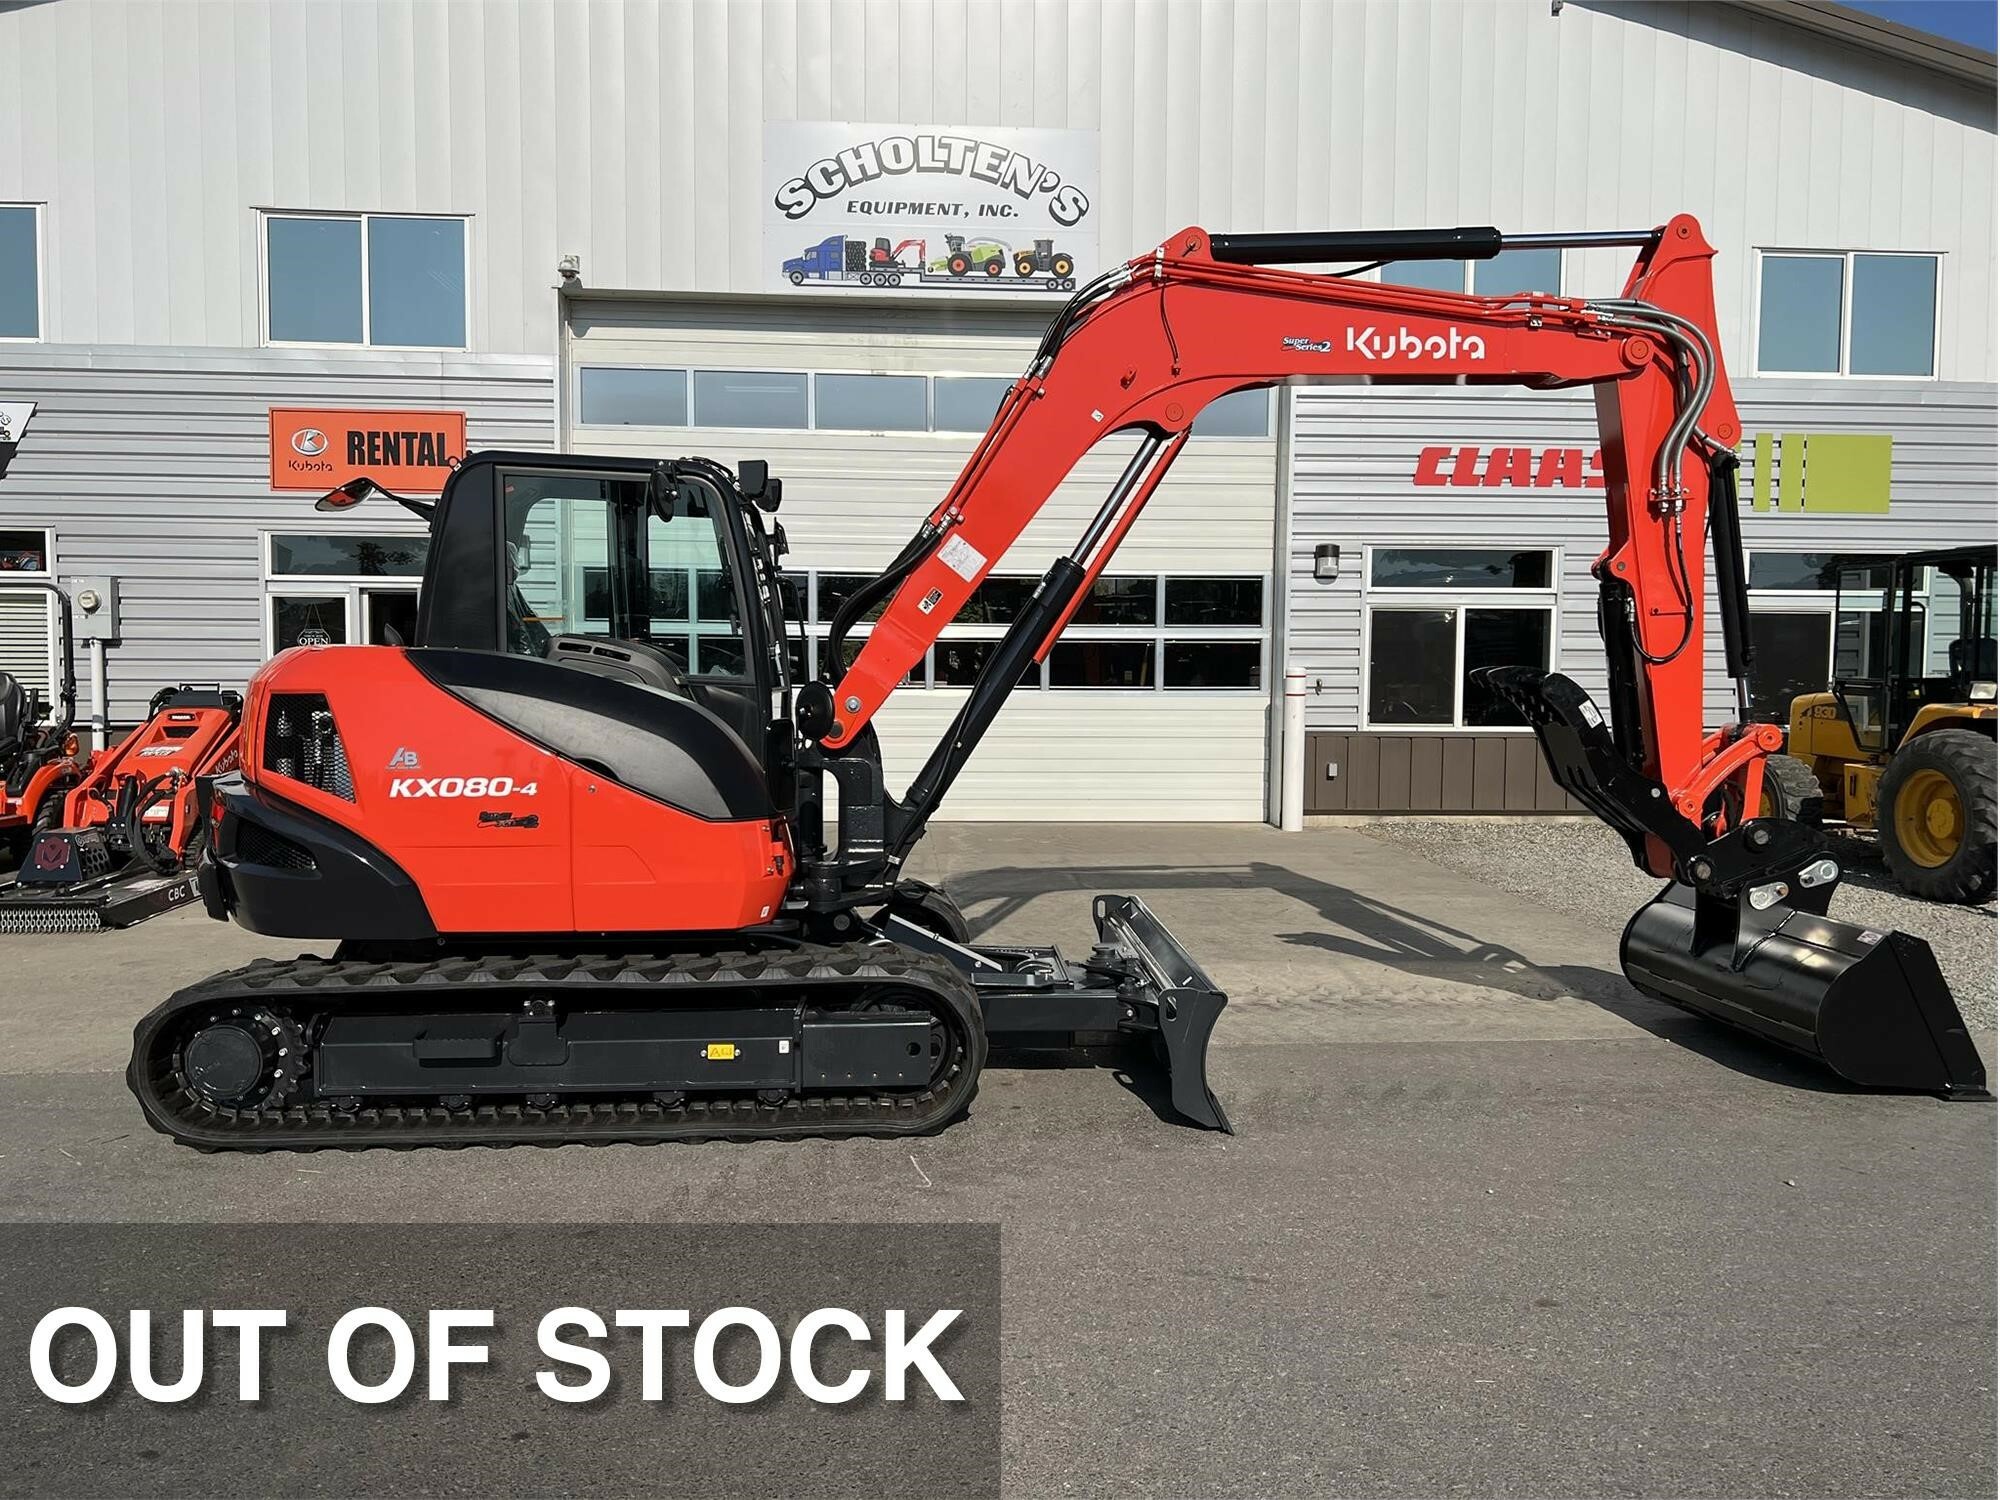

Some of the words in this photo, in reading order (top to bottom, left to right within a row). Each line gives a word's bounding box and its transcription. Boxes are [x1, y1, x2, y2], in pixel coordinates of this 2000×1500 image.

[774, 135, 1090, 227] SCHOLTEN'S
[847, 200, 970, 218] EQUIPMENT,
[978, 204, 1019, 218] INC.
[1282, 336, 1310, 346] Super
[1346, 326, 1486, 360] Kubota
[347, 431, 451, 467] RENTAL
[288, 460, 333, 472] Kubota
[299, 637, 329, 646] OPEN
[214, 749, 239, 775] Kubota
[389, 777, 538, 798] KX080-4
[168, 885, 186, 902] CBC
